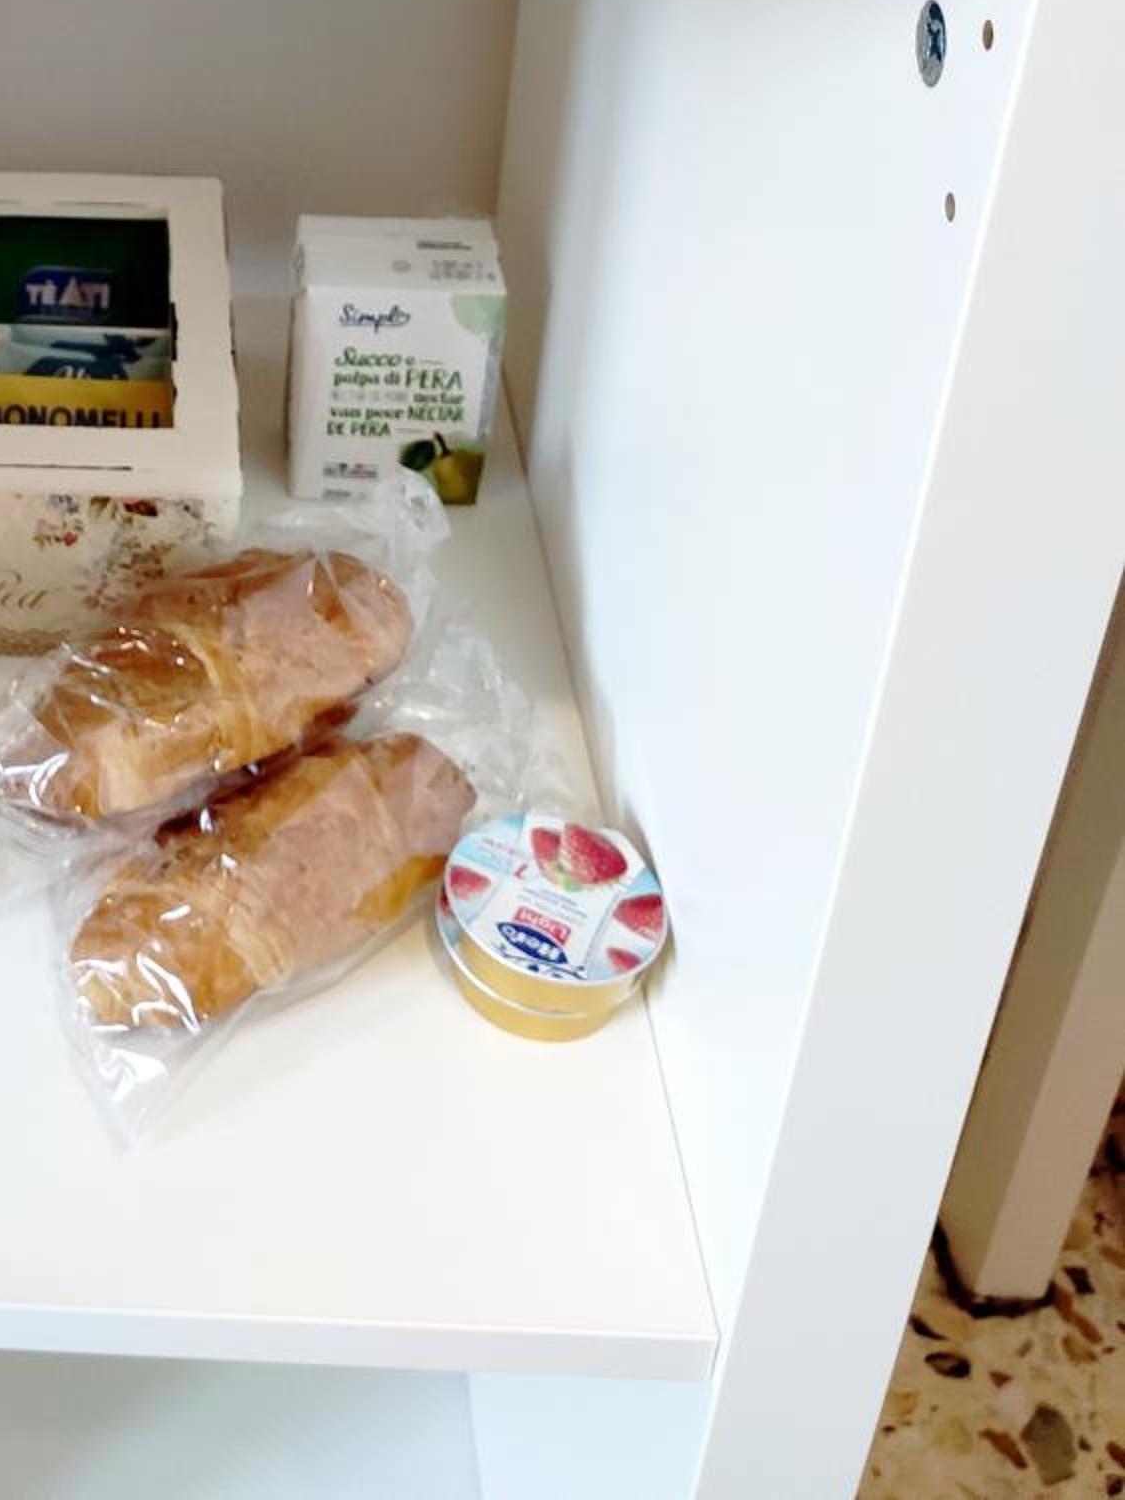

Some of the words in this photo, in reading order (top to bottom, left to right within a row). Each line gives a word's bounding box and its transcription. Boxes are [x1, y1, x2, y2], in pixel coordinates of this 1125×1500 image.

[334, 346, 402, 367] Succo
[333, 370, 379, 387] polpa
[383, 371, 400, 385] di
[404, 368, 462, 389] PERA
[407, 404, 464, 421] NECTAR
[327, 419, 345, 436] DE
[350, 420, 392, 437] PERA
